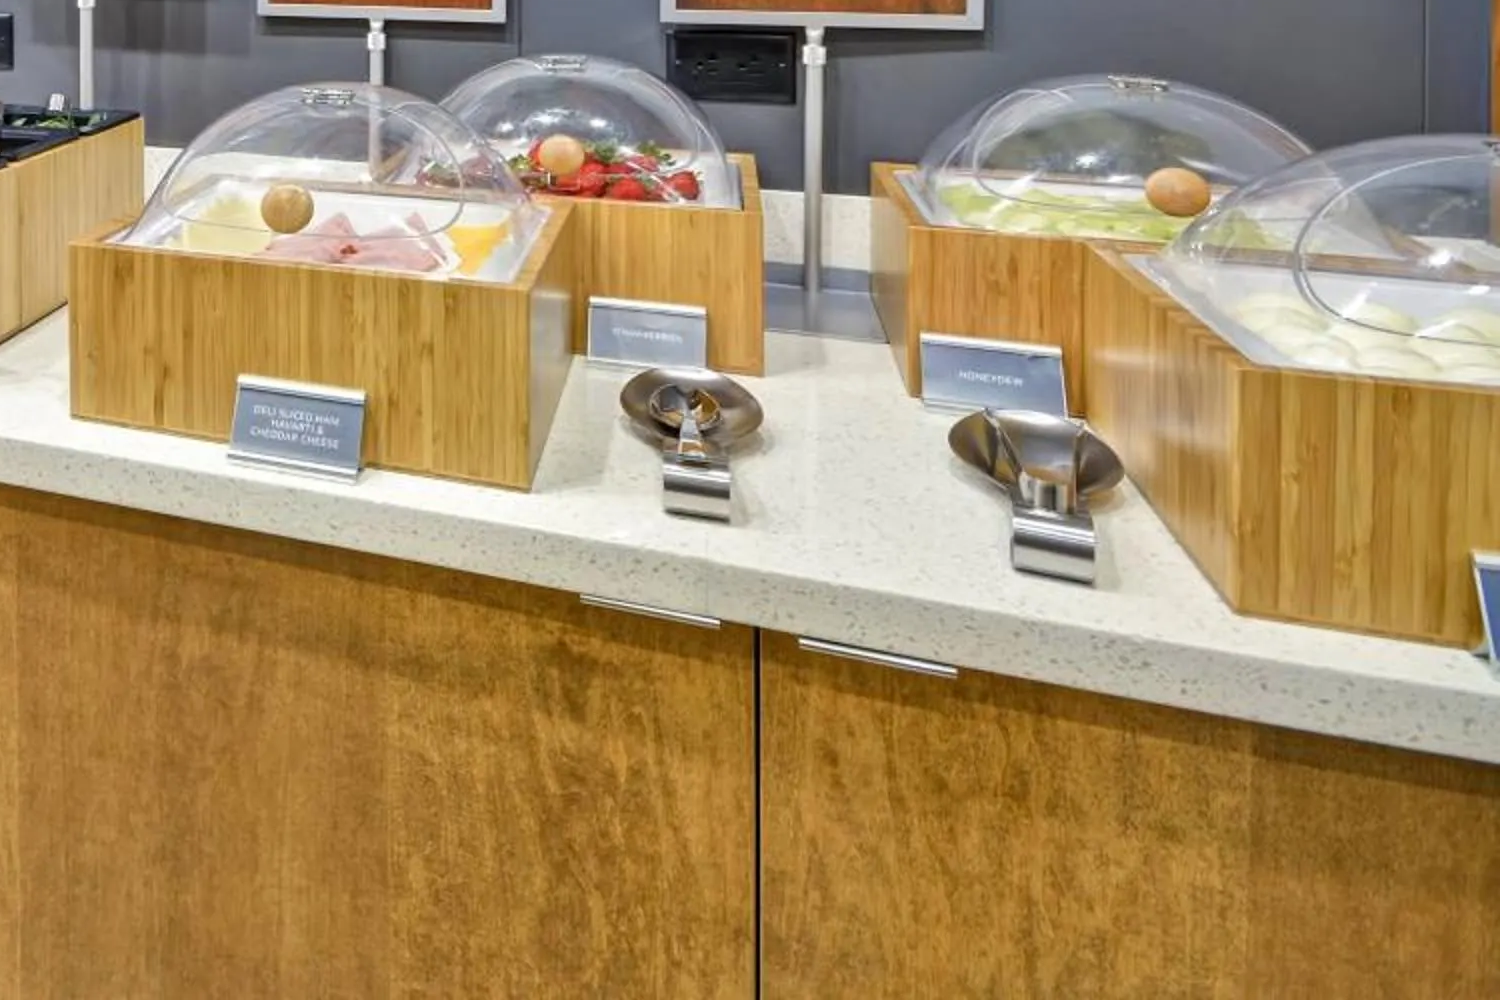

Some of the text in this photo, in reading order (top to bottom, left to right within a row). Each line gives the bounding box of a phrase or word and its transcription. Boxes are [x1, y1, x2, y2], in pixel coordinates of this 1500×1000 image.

[253, 405, 276, 416] DELI
[279, 408, 313, 422] SLICED
[271, 419, 314, 434] HAVARTI
[250, 425, 340, 450] CHEDDAR CHEESE
